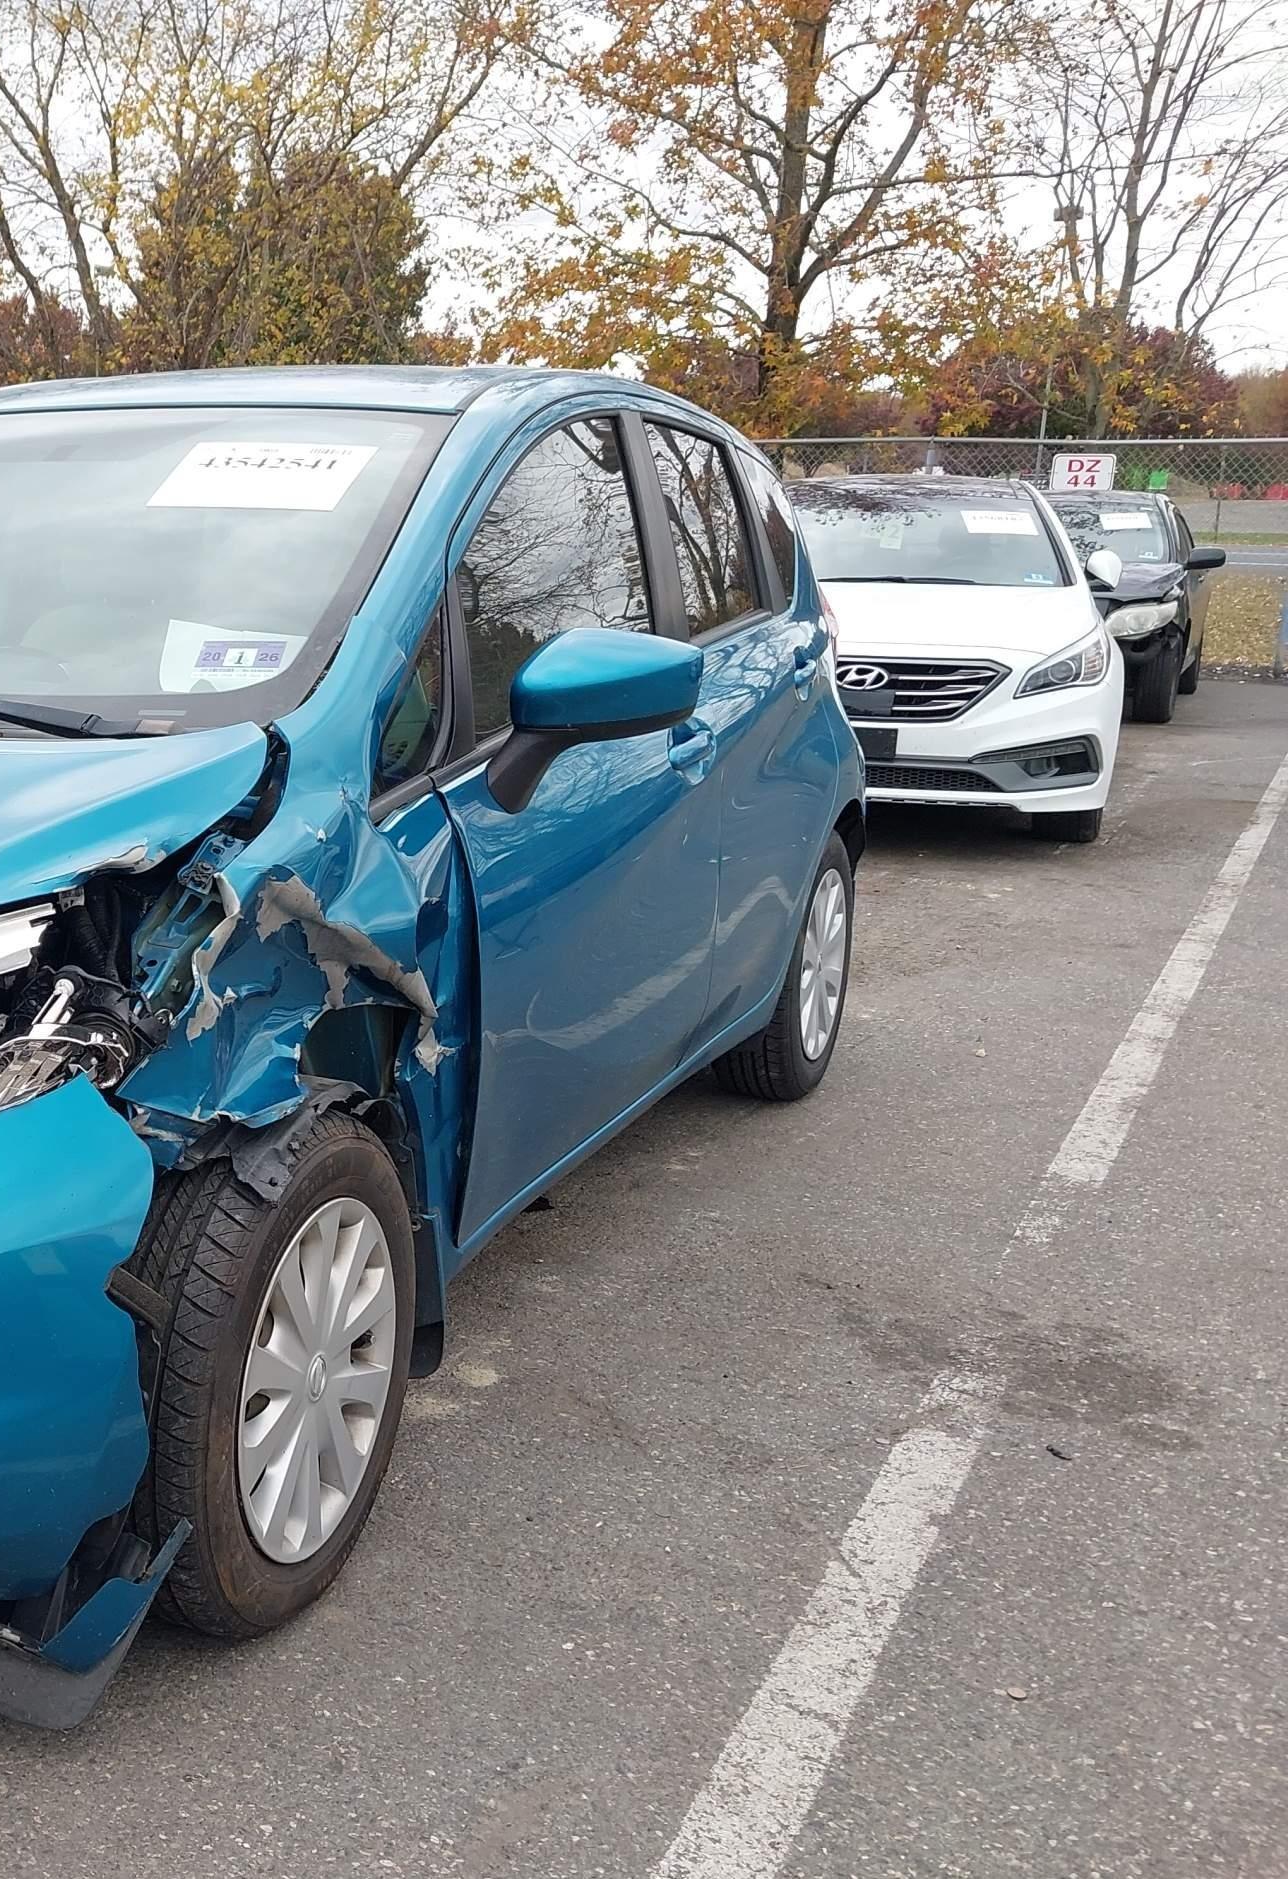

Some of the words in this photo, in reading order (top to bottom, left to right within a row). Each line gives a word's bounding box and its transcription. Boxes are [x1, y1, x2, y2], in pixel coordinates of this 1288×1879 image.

[1068, 459, 1102, 473] DZ
[1066, 474, 1097, 488] 44
[202, 651, 221, 661] 20
[259, 653, 280, 662] 26
